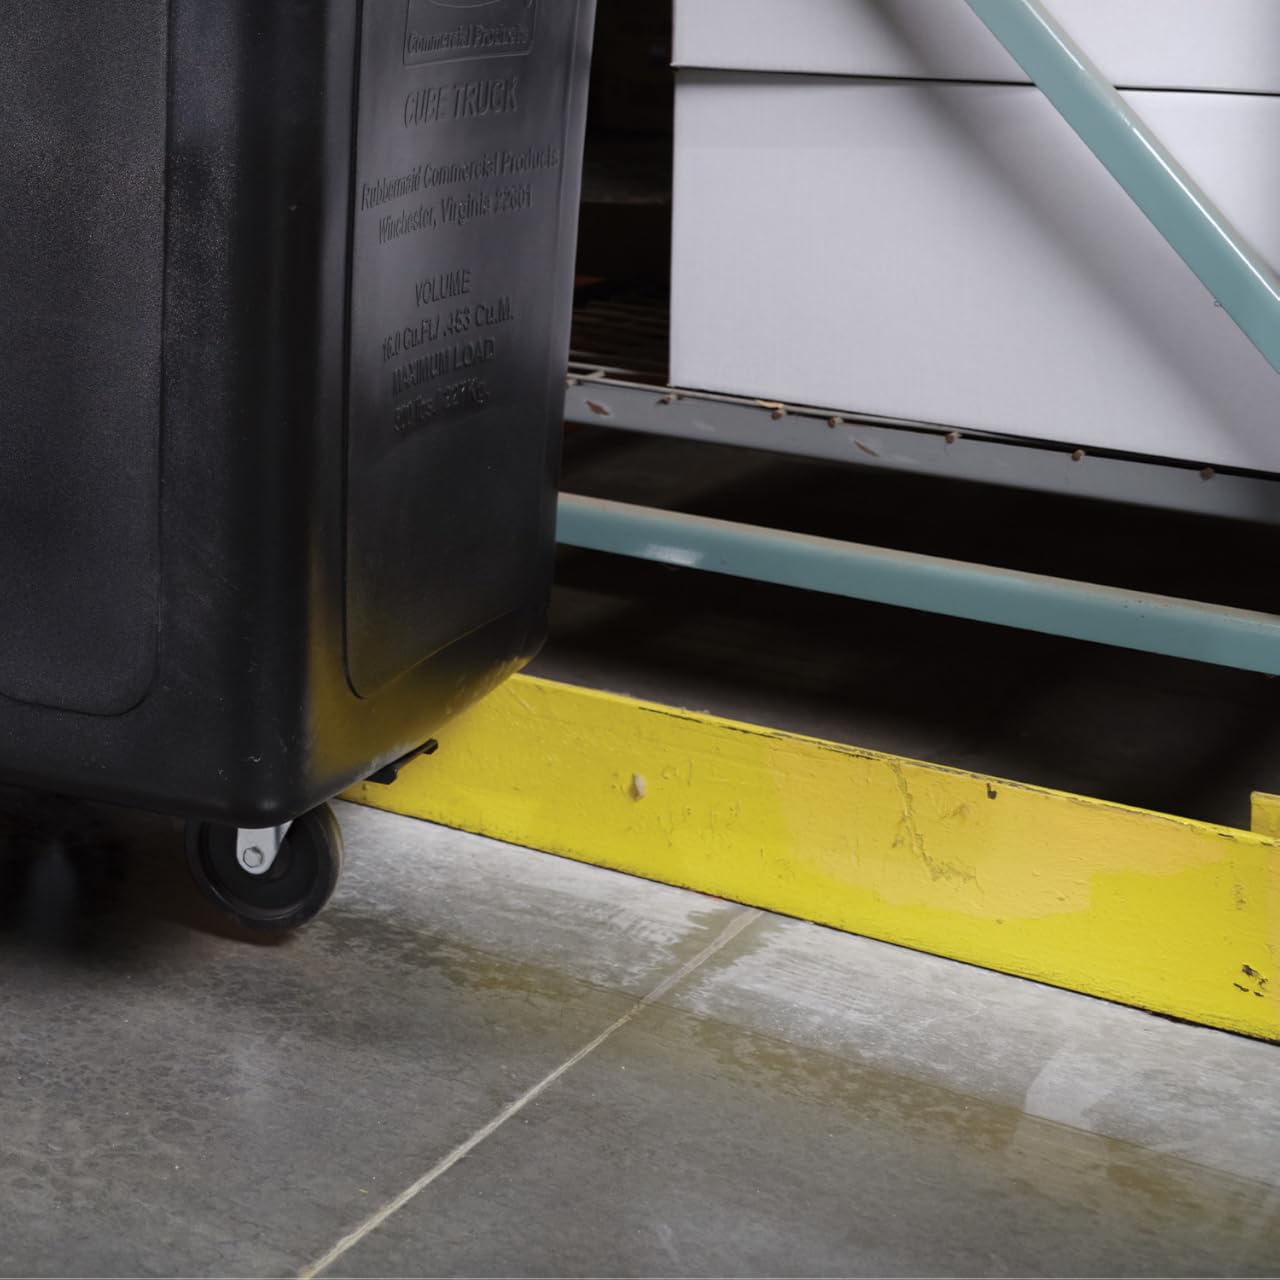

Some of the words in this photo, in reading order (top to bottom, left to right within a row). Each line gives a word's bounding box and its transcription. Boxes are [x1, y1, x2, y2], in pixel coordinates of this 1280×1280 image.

[453, 77, 519, 120] TRUCK
[361, 165, 421, 211] Rubbermaid
[424, 151, 498, 190] Commercial
[415, 269, 471, 307] VOLUME
[453, 337, 495, 371] LOAD
